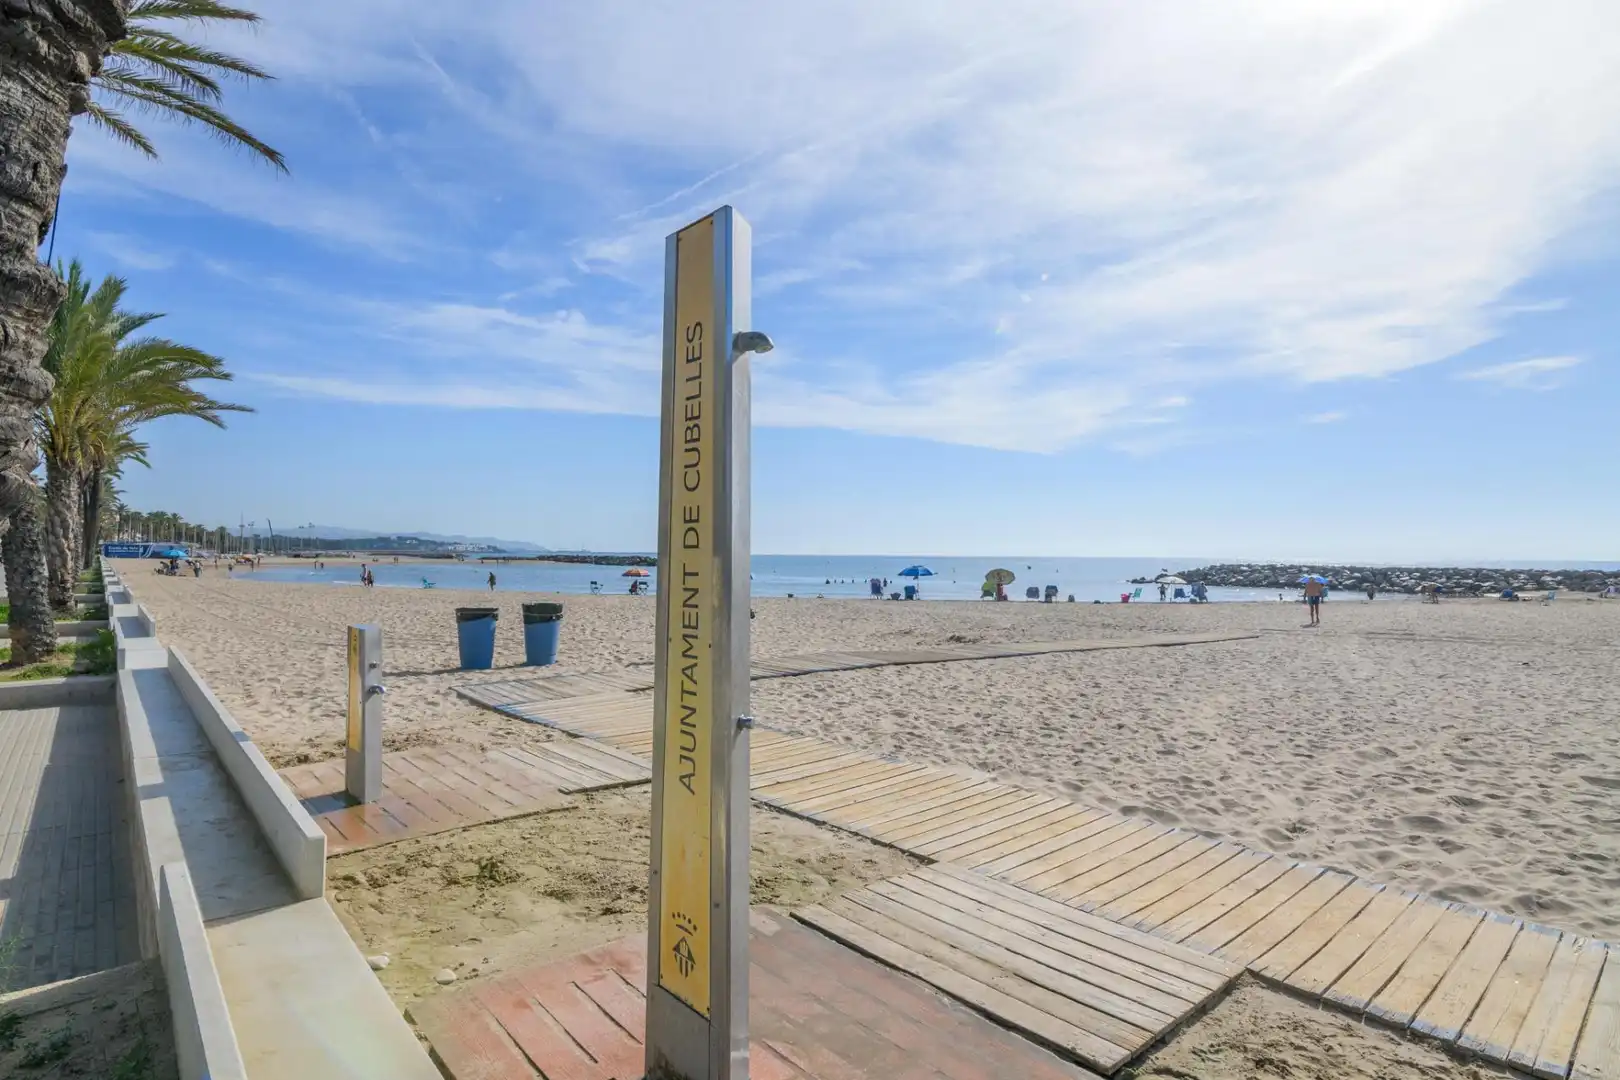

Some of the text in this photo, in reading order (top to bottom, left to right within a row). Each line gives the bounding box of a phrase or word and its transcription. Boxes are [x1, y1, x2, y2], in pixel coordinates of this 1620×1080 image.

[679, 320, 703, 795] AJUNTAMENT DE CUBELLES
